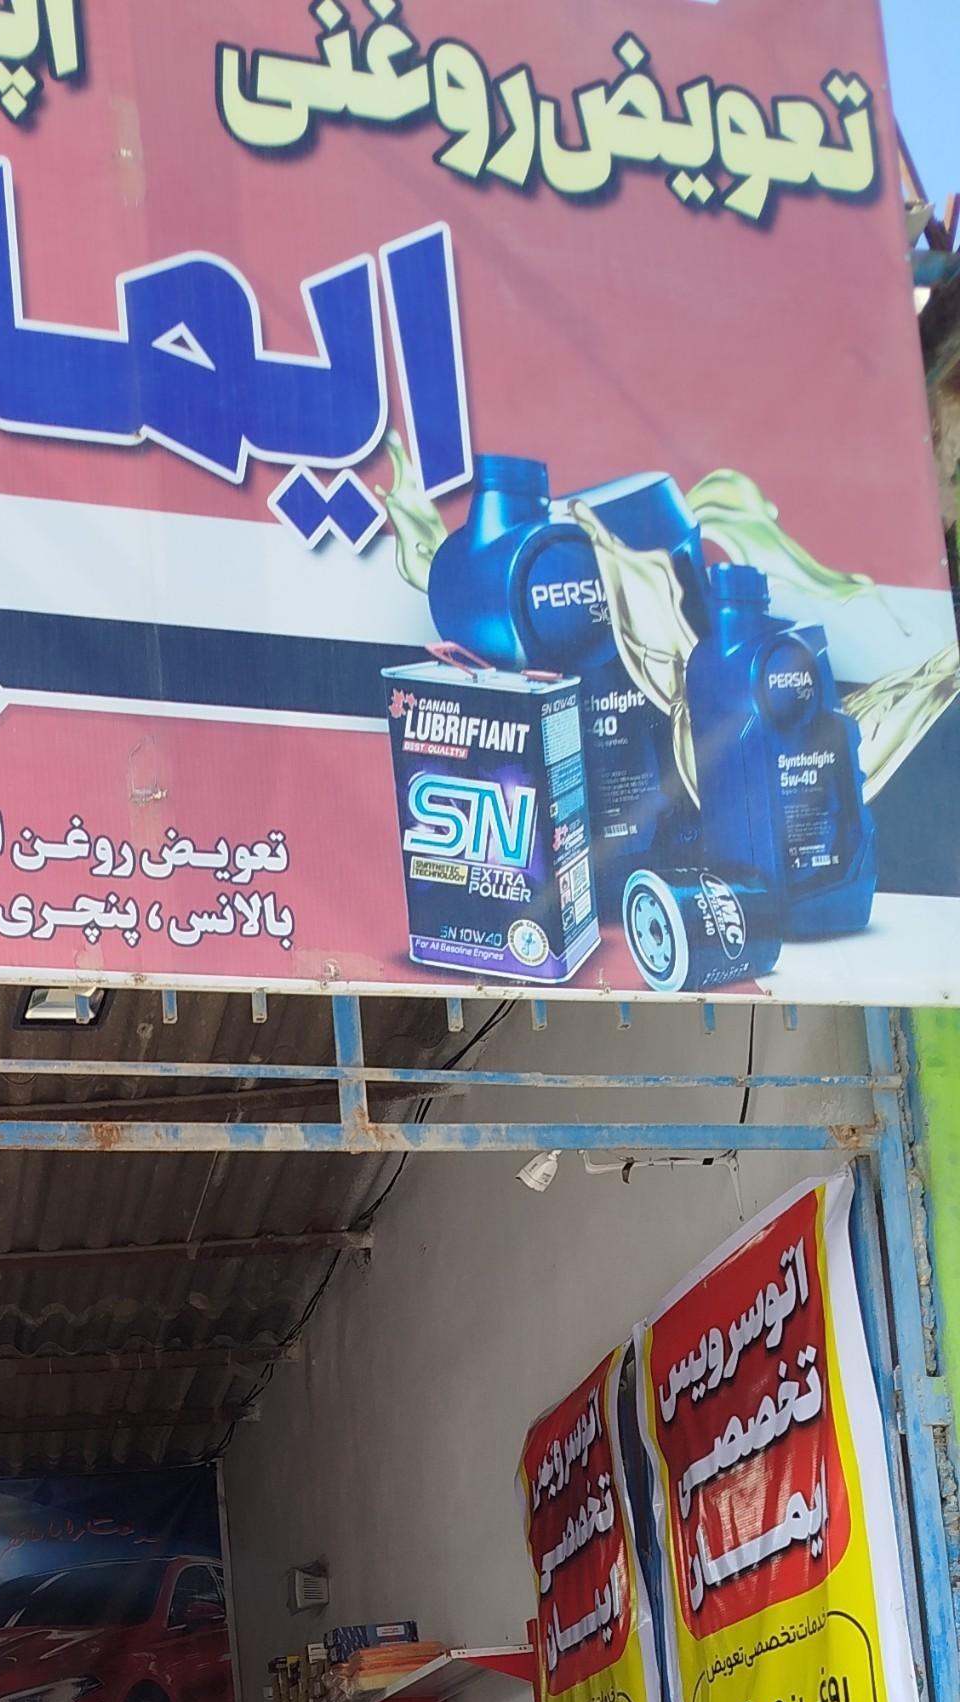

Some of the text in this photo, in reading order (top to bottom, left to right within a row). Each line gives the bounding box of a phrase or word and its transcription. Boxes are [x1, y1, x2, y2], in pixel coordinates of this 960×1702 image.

[221, 0, 876, 220] تعویض روغنی
[531, 578, 608, 611] PERSI
[418, 697, 461, 714] CANADA
[768, 671, 813, 690] PERSIA
[404, 709, 531, 754] LUBRIFIANT
[777, 750, 836, 771] Syntholight
[11, 814, 136, 878] روغن
[404, 771, 538, 868] SN
[141, 827, 290, 884] تعویض
[470, 867, 527, 888] EXTRA
[468, 881, 532, 903] POWER
[706, 880, 744, 945] AMC
[657, 1236, 810, 1422] اتوسرویس
[676, 1345, 825, 1521] تخصصی
[539, 1471, 616, 1595] تخصصی
[689, 1456, 829, 1613] ایمان
[743, 1622, 798, 1667] تخصصی
